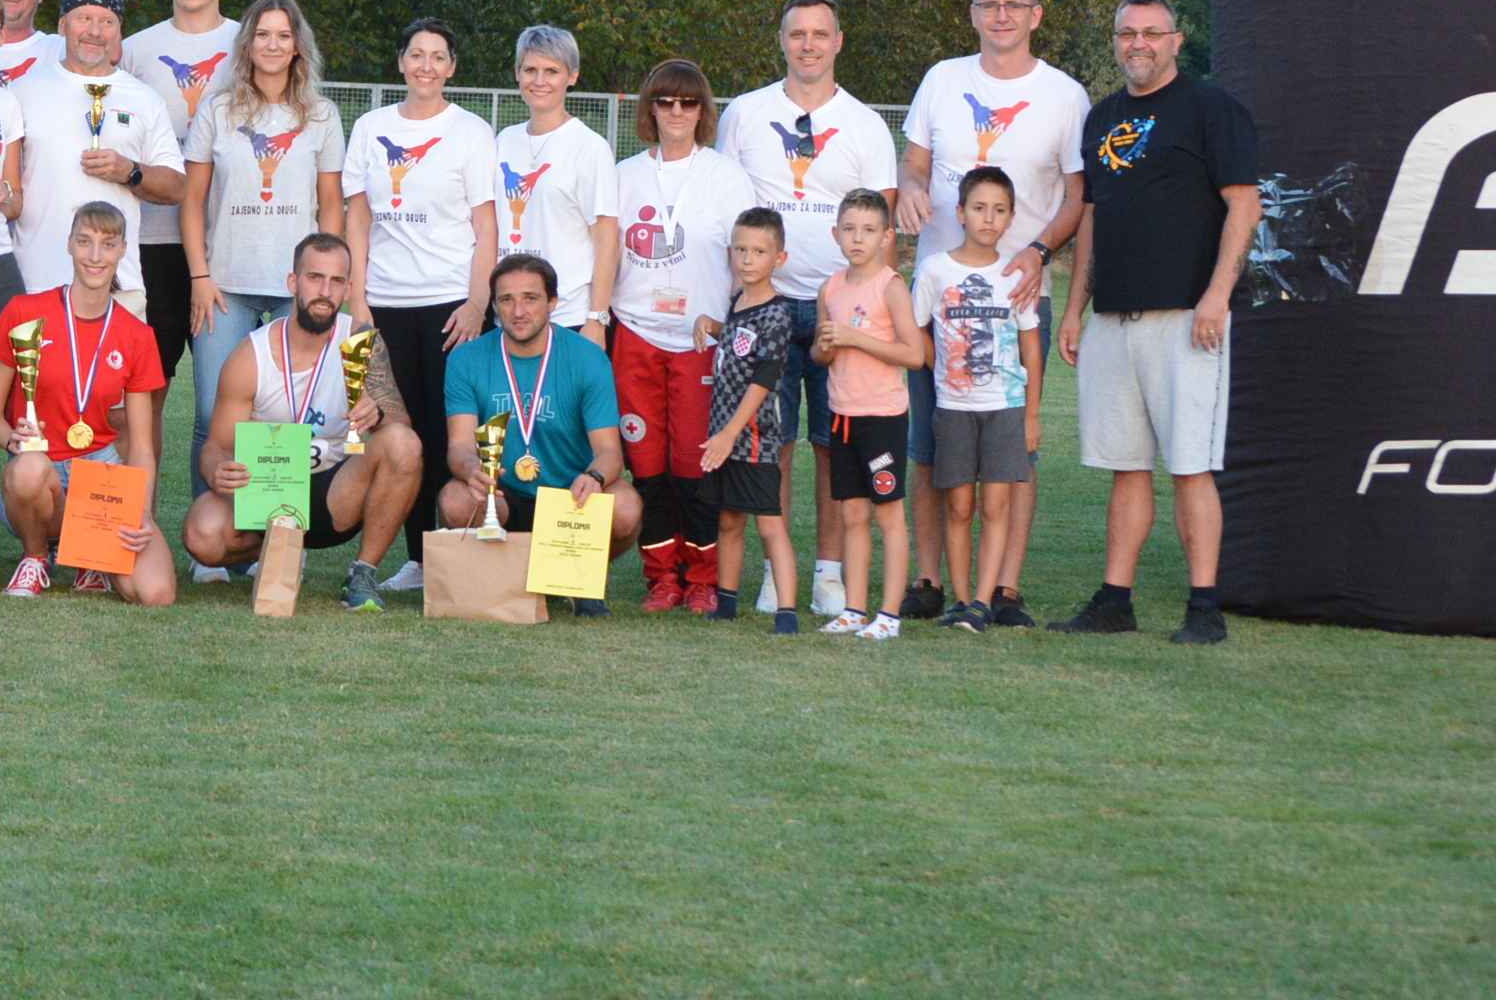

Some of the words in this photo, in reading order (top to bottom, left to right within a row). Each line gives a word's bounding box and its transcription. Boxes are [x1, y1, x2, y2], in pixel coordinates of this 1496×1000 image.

[264, 205, 273, 216] ZA
[257, 456, 291, 464] DIPLOMA
[557, 521, 591, 531] DIPLOMA
